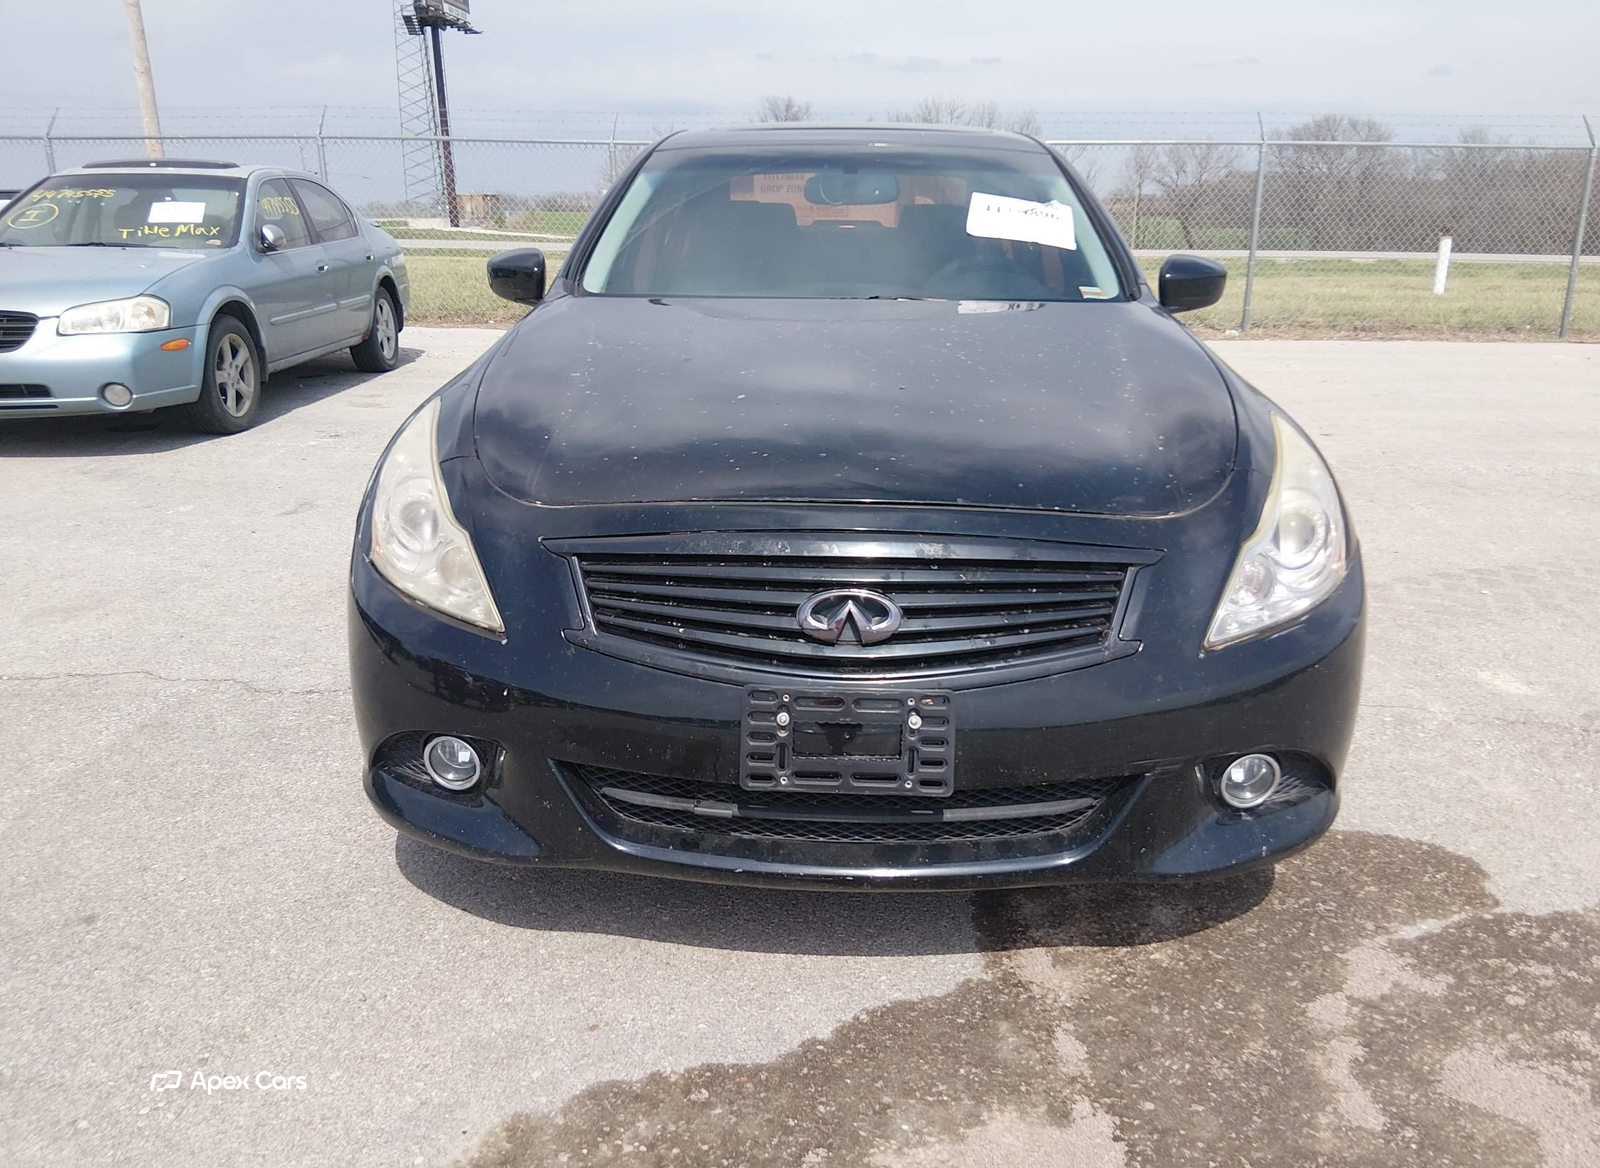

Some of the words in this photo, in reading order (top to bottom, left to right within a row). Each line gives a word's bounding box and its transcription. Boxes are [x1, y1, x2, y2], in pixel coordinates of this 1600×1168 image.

[760, 184, 784, 194] DROP
[785, 184, 804, 193] ZON
[174, 223, 220, 237] Max
